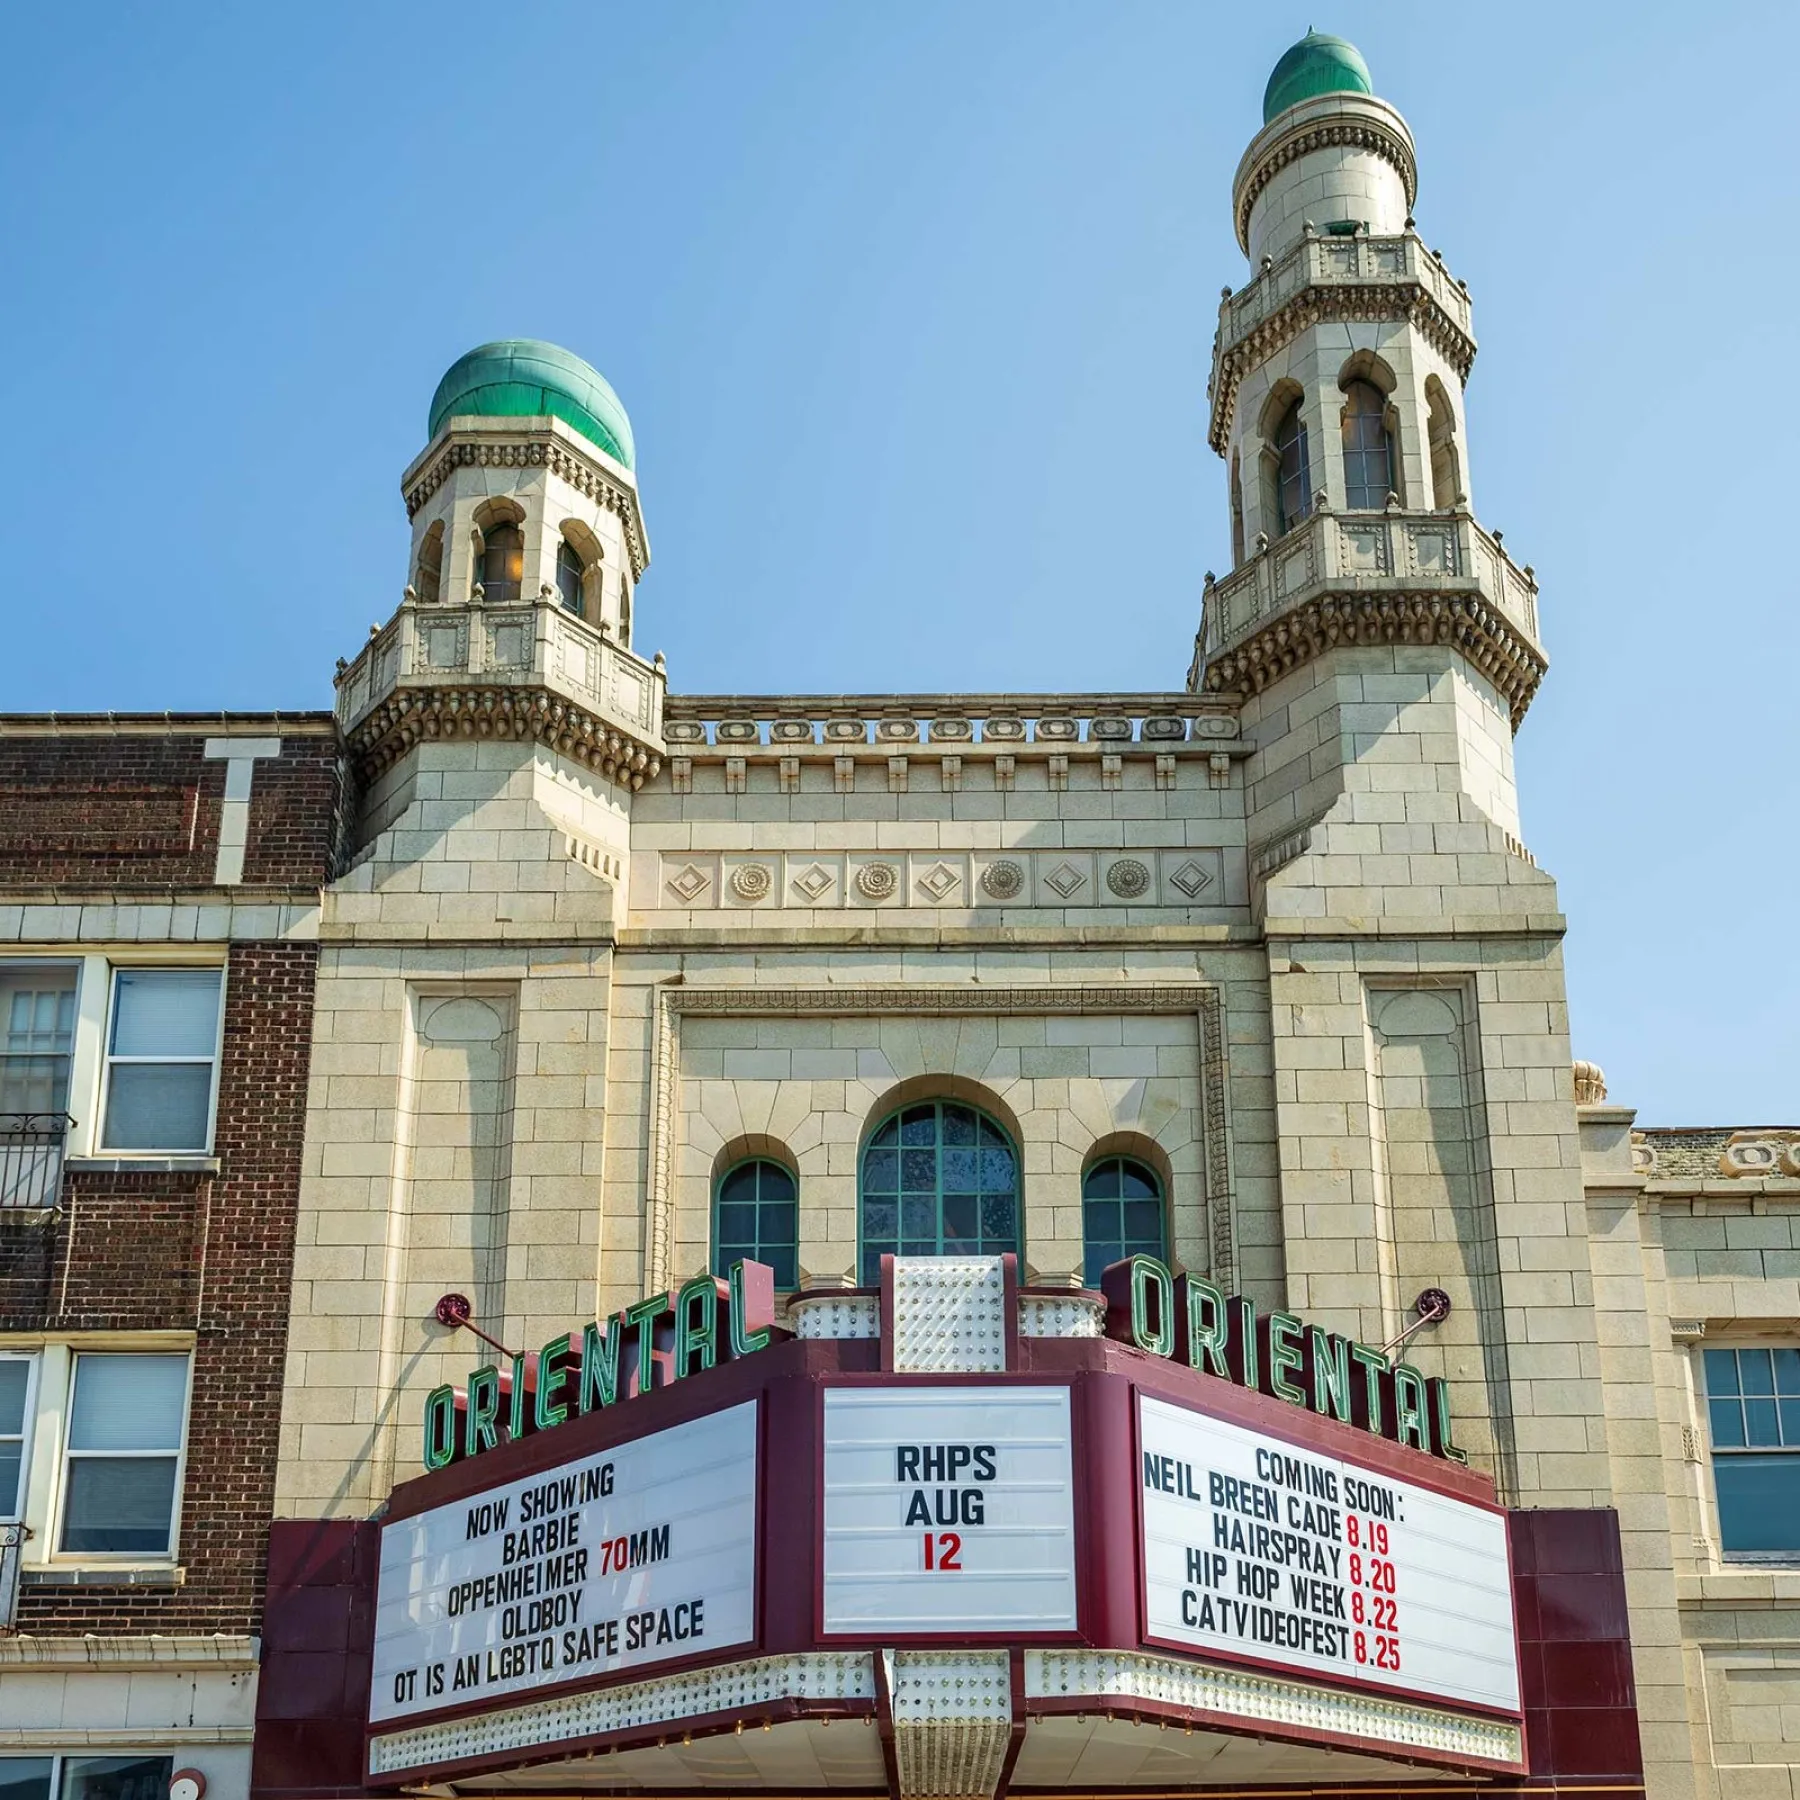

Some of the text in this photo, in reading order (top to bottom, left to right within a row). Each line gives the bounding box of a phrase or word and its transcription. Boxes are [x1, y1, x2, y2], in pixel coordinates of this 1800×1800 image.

[424, 1258, 774, 1472] ORIENTAL
[1131, 1253, 1468, 1464] ORIENTAL
[466, 1463, 614, 1540] NOW SHOWING
[898, 1445, 996, 1482] RHPS
[1144, 1451, 1388, 1555] NEIL BREEN CADE 8.19
[1256, 1447, 1404, 1523] COMING SOON:
[503, 1512, 579, 1566] BARBIE
[905, 1489, 984, 1526] AUG
[448, 1524, 670, 1617] OPPENHEIMER 70MM
[924, 1533, 962, 1571] 12
[1187, 1547, 1398, 1633] HIP HOP WEEK 8.22
[1214, 1513, 1396, 1594] HAIRSPRAY 8.20
[394, 1600, 704, 1703] OT IS AN LGBTQ SAFE SPACE
[502, 1589, 583, 1640] OLDBOY
[1182, 1590, 1400, 1671] CATVIDEOFEST 8.25
